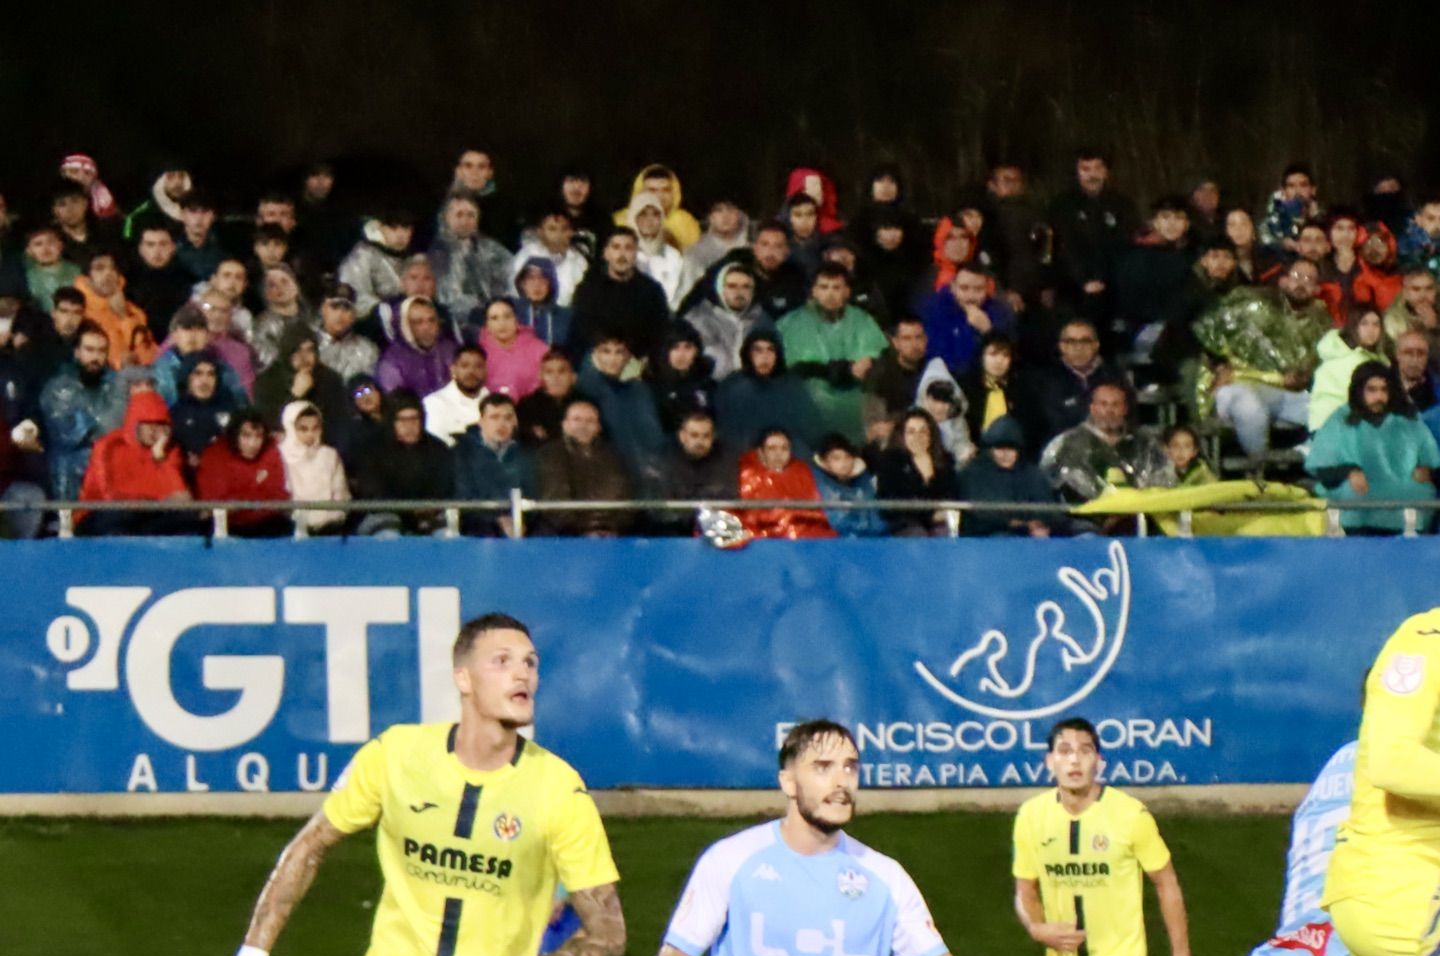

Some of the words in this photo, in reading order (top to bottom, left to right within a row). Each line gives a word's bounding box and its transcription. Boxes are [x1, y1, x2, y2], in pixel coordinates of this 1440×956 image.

[775, 720, 1018, 753] FNCISCO
[127, 753, 328, 793] ALQU
[861, 762, 988, 788] TERAPIA
[1000, 760, 1187, 784] AVZADA.
[403, 837, 514, 880] PAMESA
[1044, 862, 1111, 877] PAMESA
